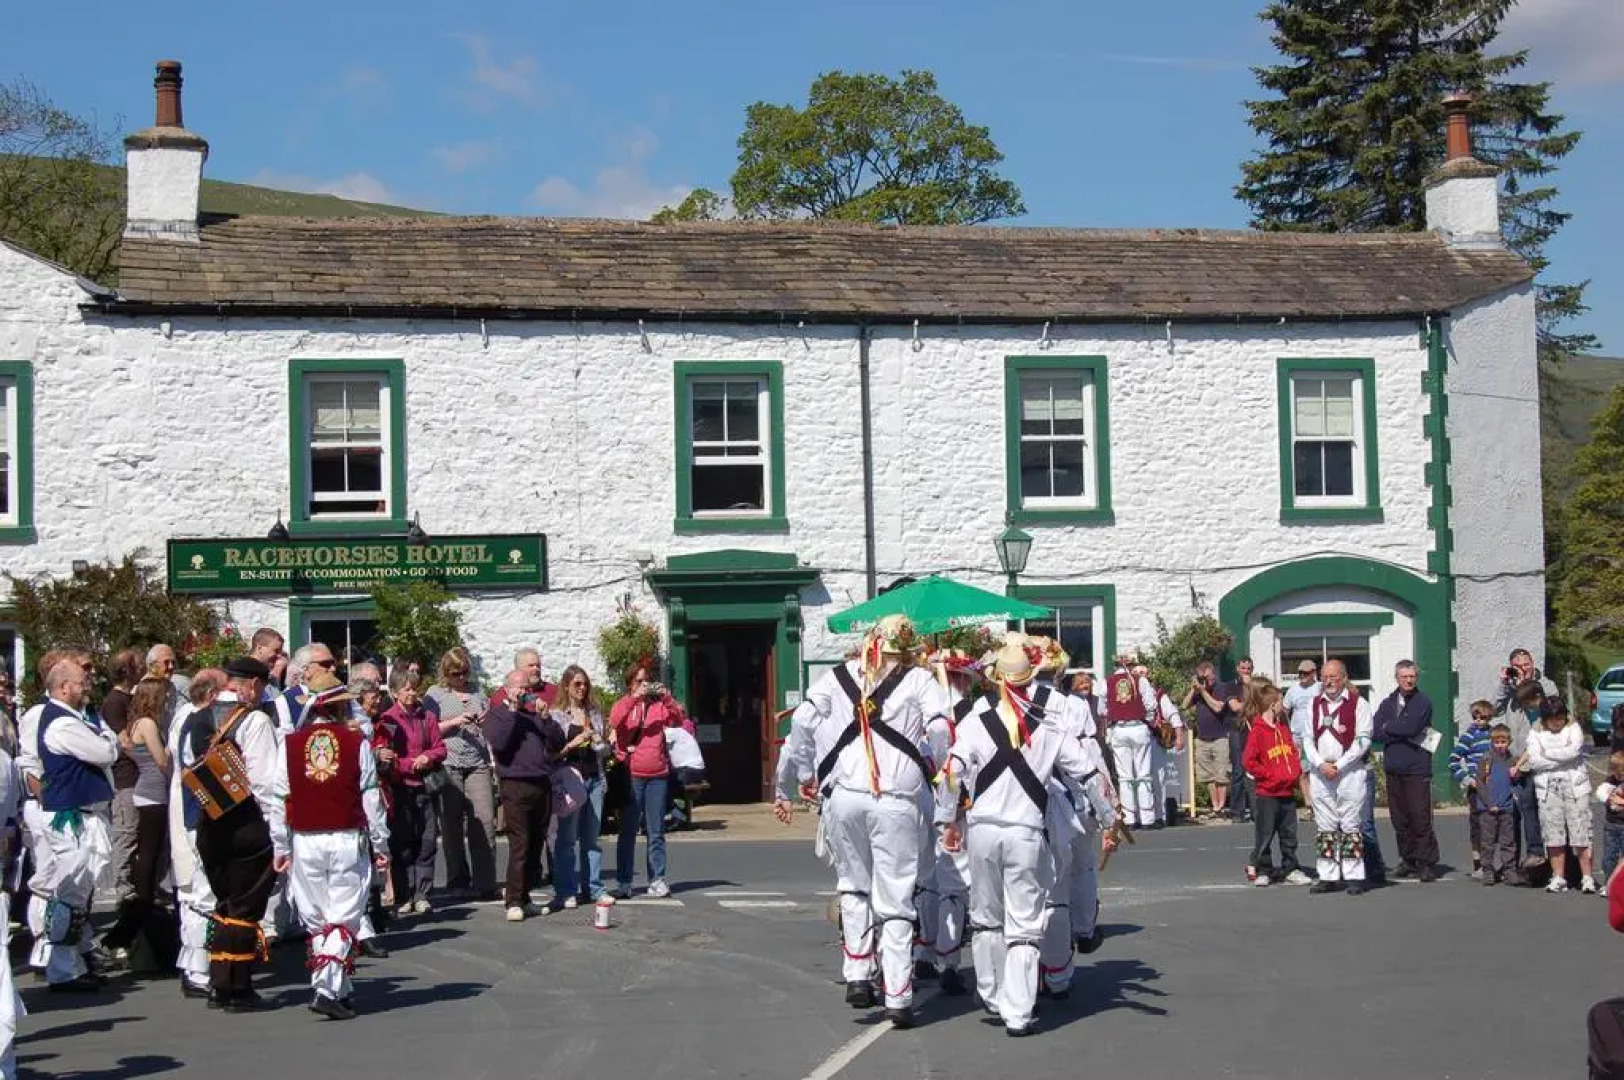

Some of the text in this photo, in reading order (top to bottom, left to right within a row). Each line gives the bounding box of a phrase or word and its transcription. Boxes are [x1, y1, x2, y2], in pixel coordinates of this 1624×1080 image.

[223, 544, 493, 567] RACEHORSES HOTEL
[409, 567, 443, 577] GOOD
[445, 566, 478, 577] FOOD
